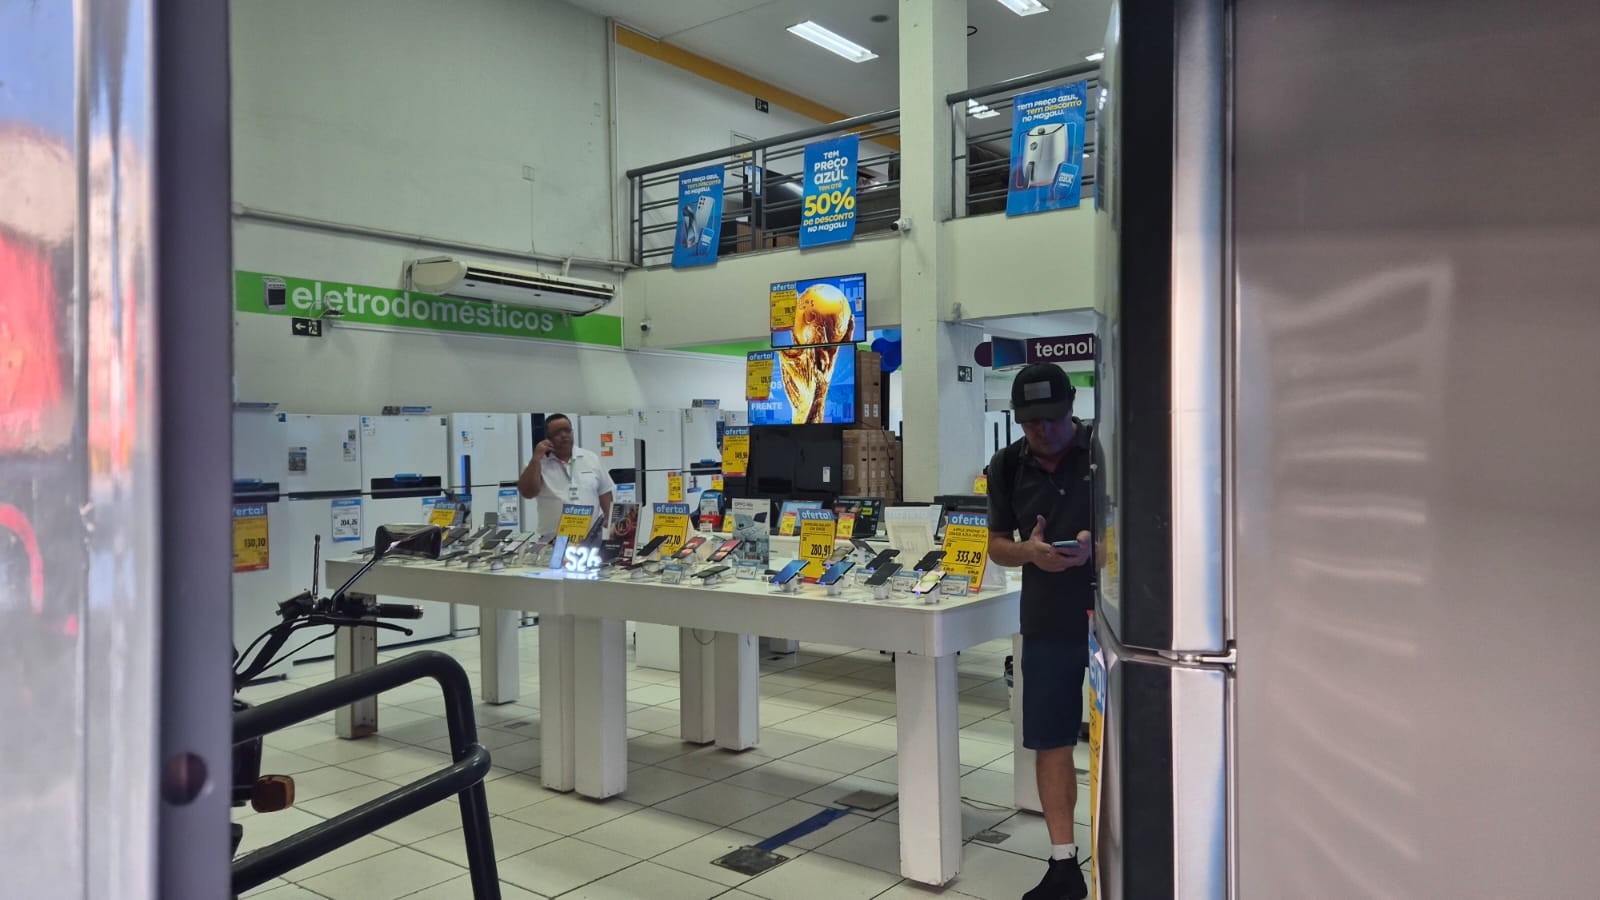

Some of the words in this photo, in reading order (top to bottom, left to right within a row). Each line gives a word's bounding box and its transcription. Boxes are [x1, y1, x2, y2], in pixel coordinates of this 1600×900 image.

[804, 186, 856, 218] 50%
[291, 282, 554, 332] eletrodomésticos
[1035, 337, 1095, 357] tecnol
[751, 402, 783, 411] FRENTE
[656, 503, 687, 515] oferta!
[801, 510, 832, 520] oferta!
[565, 546, 602, 572] S26
[954, 550, 982, 565] 333,29
